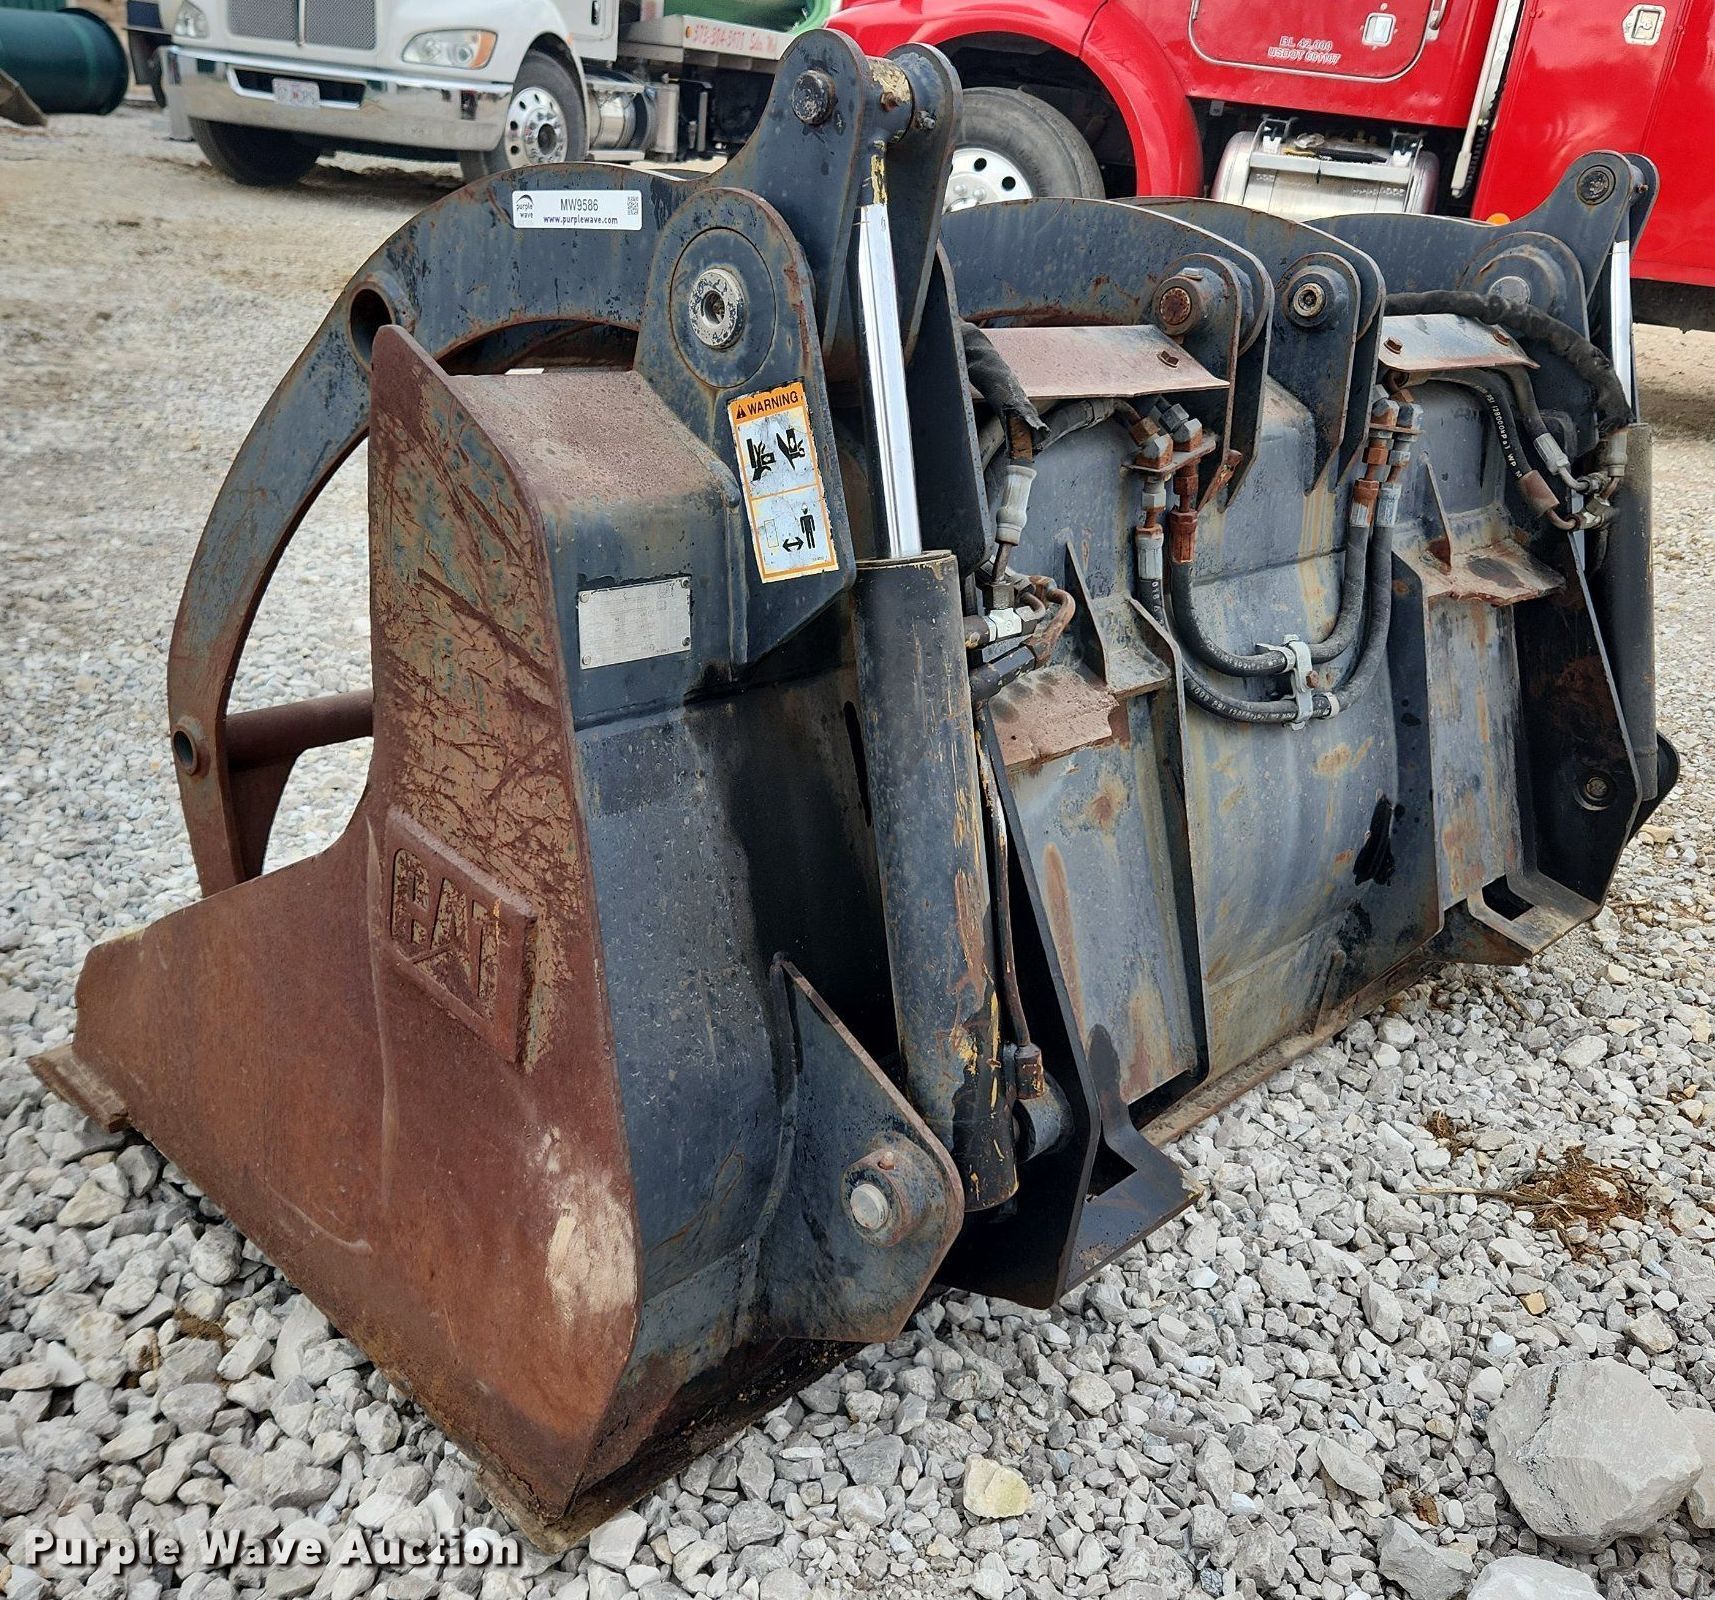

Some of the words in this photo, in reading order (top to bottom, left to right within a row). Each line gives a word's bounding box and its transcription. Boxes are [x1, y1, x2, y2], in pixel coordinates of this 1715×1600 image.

[1268, 46, 1305, 60] USDOT
[516, 202, 533, 211] purple
[560, 198, 599, 211] MW9586
[543, 214, 618, 225] www.purplewave.com
[747, 390, 799, 415] WARNING
[1507, 453, 1517, 468] WP
[390, 848, 499, 1023] CAT
